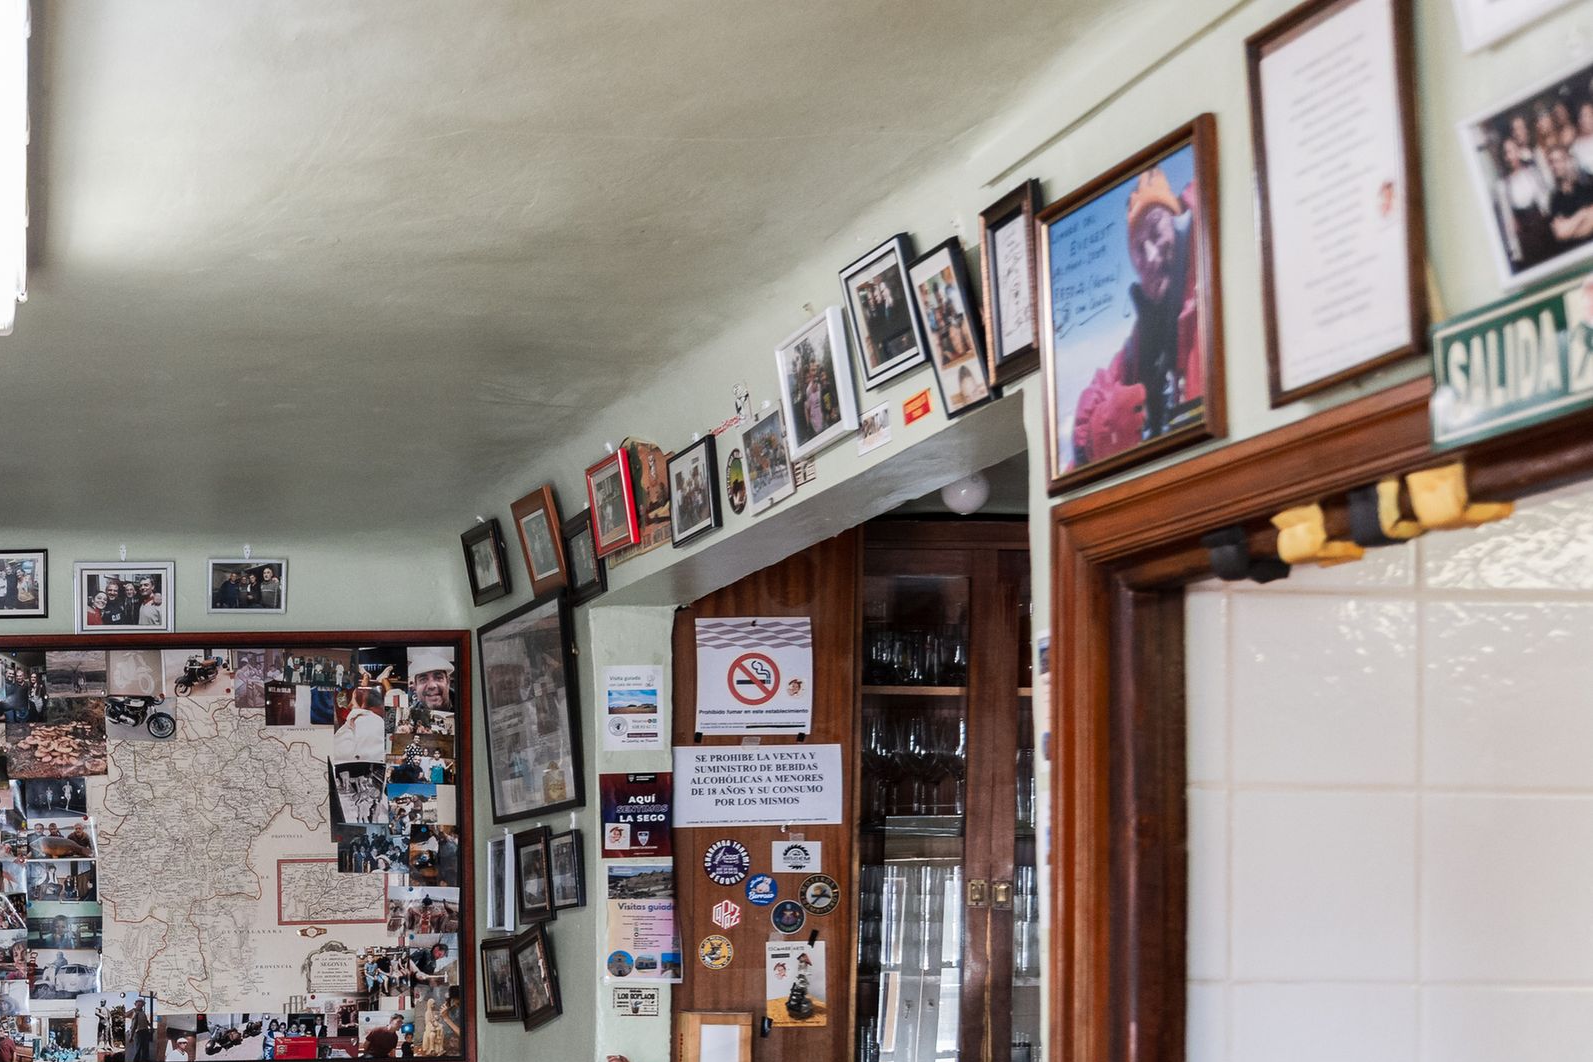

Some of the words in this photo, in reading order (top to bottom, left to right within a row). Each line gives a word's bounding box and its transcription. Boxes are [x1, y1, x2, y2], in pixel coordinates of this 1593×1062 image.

[1447, 309, 1563, 420] SALIDA
[710, 754, 754, 762] PROHIBE
[757, 753, 770, 761] LA
[695, 765, 757, 773] SUMINISTRO
[760, 764, 773, 772] DE
[776, 763, 818, 771] BEBIDAS
[690, 774, 762, 784] ALCOHÓLICAS
[775, 774, 823, 782] MENORES
[720, 786, 746, 794] AÑOS
[773, 785, 823, 793] CONSUMO
[628, 794, 656, 804] AQUÍ
[759, 797, 800, 805] MISMOS
[616, 804, 668, 813] SENTIMOS
[637, 814, 665, 822] SEGO
[618, 902, 646, 910] Visitas
